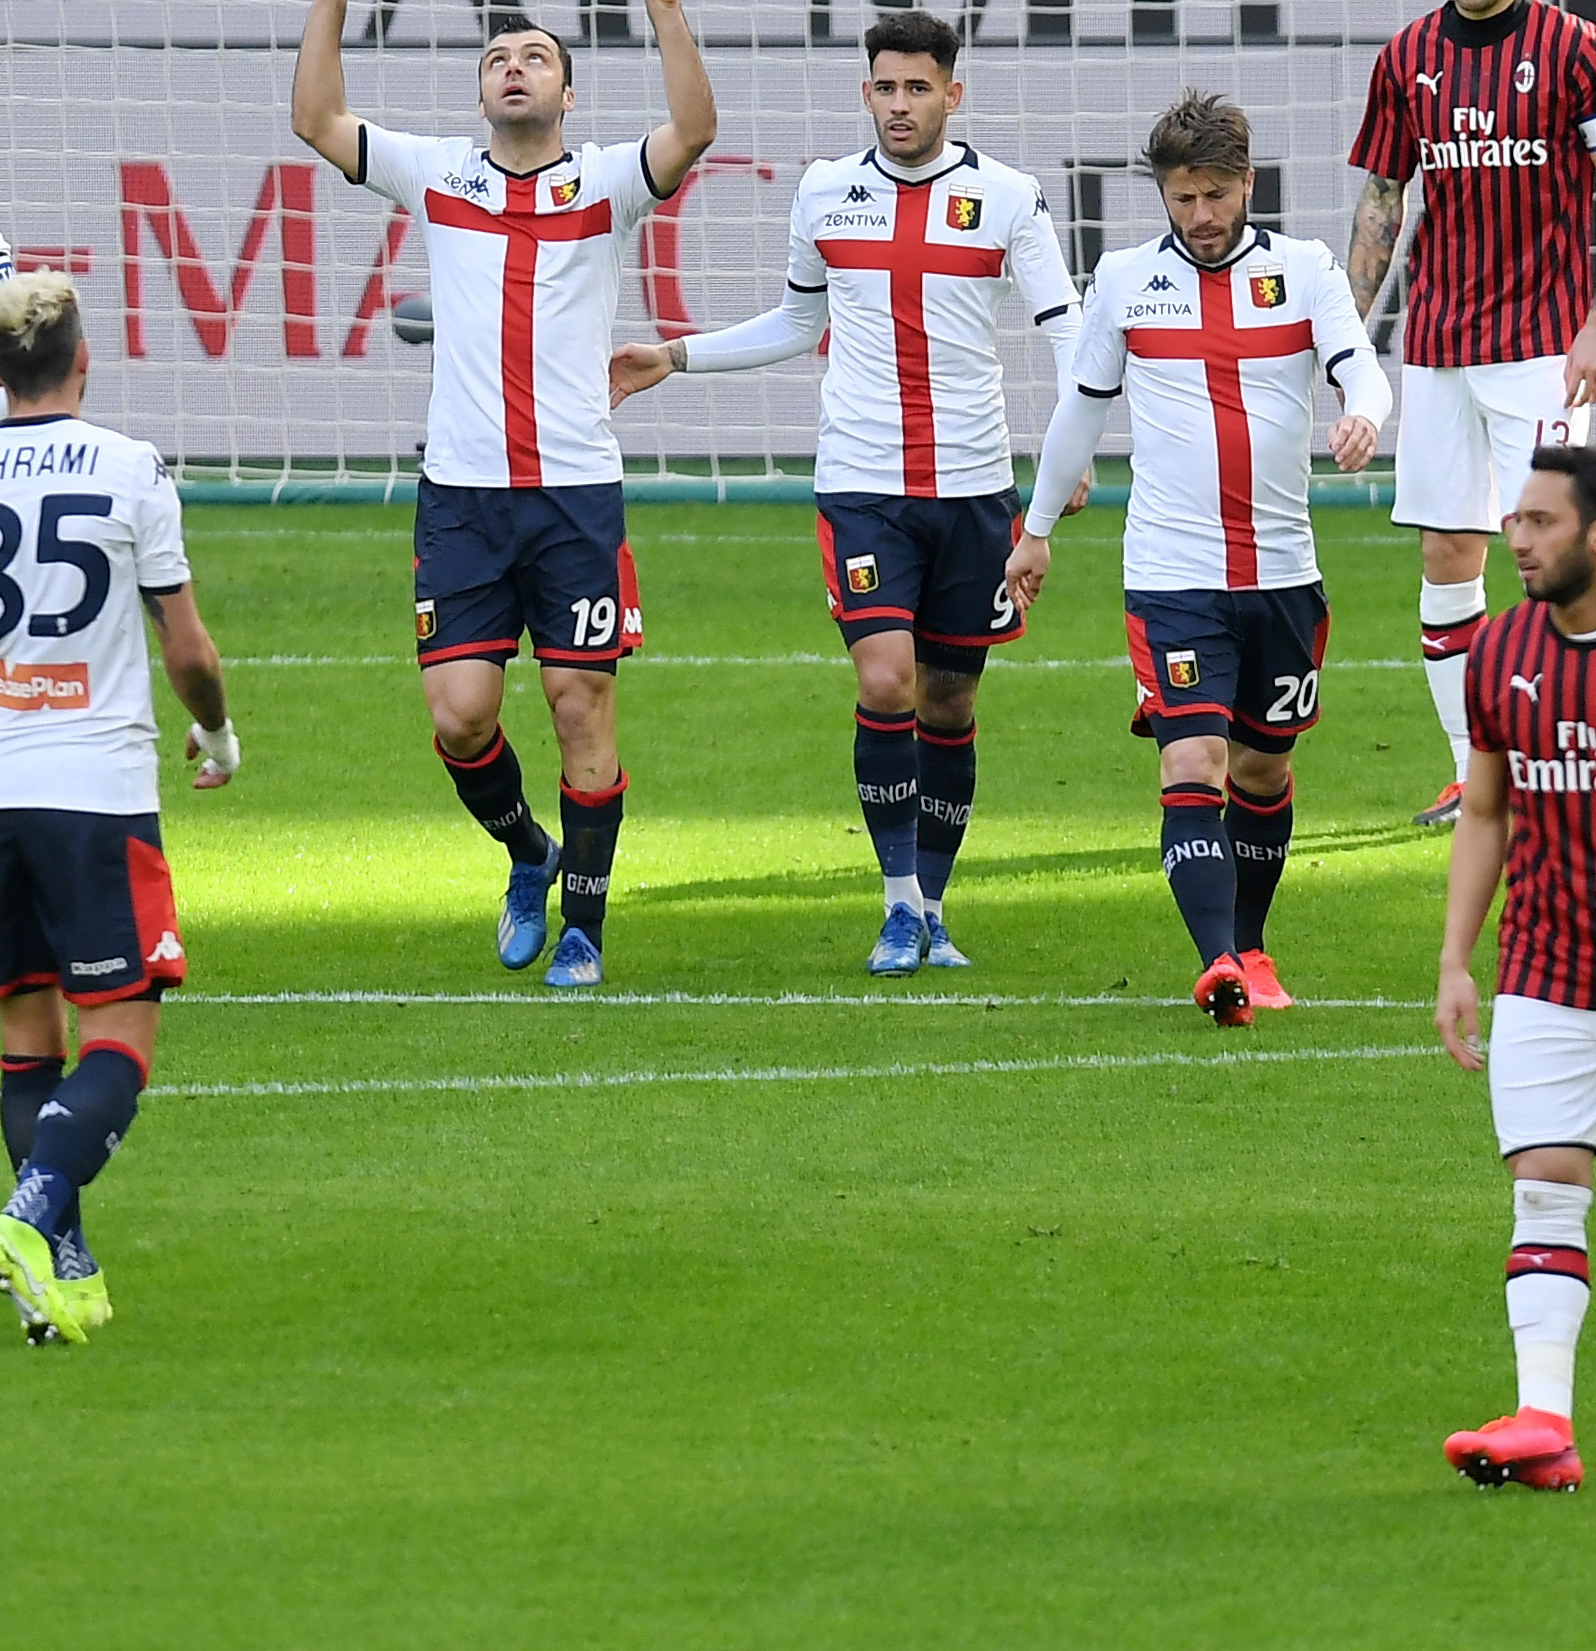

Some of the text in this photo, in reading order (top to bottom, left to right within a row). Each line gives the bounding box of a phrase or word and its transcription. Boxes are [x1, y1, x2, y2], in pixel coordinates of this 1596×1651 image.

[1453, 106, 1496, 137] Fly
[1419, 134, 1548, 171] Emirates
[990, 579, 1015, 630] 9
[570, 596, 617, 646] 19
[1266, 669, 1318, 722] 20
[858, 778, 917, 805] GENOA
[920, 795, 972, 826] GENO
[1235, 840, 1289, 862] GEN
[567, 873, 609, 896] GENO
